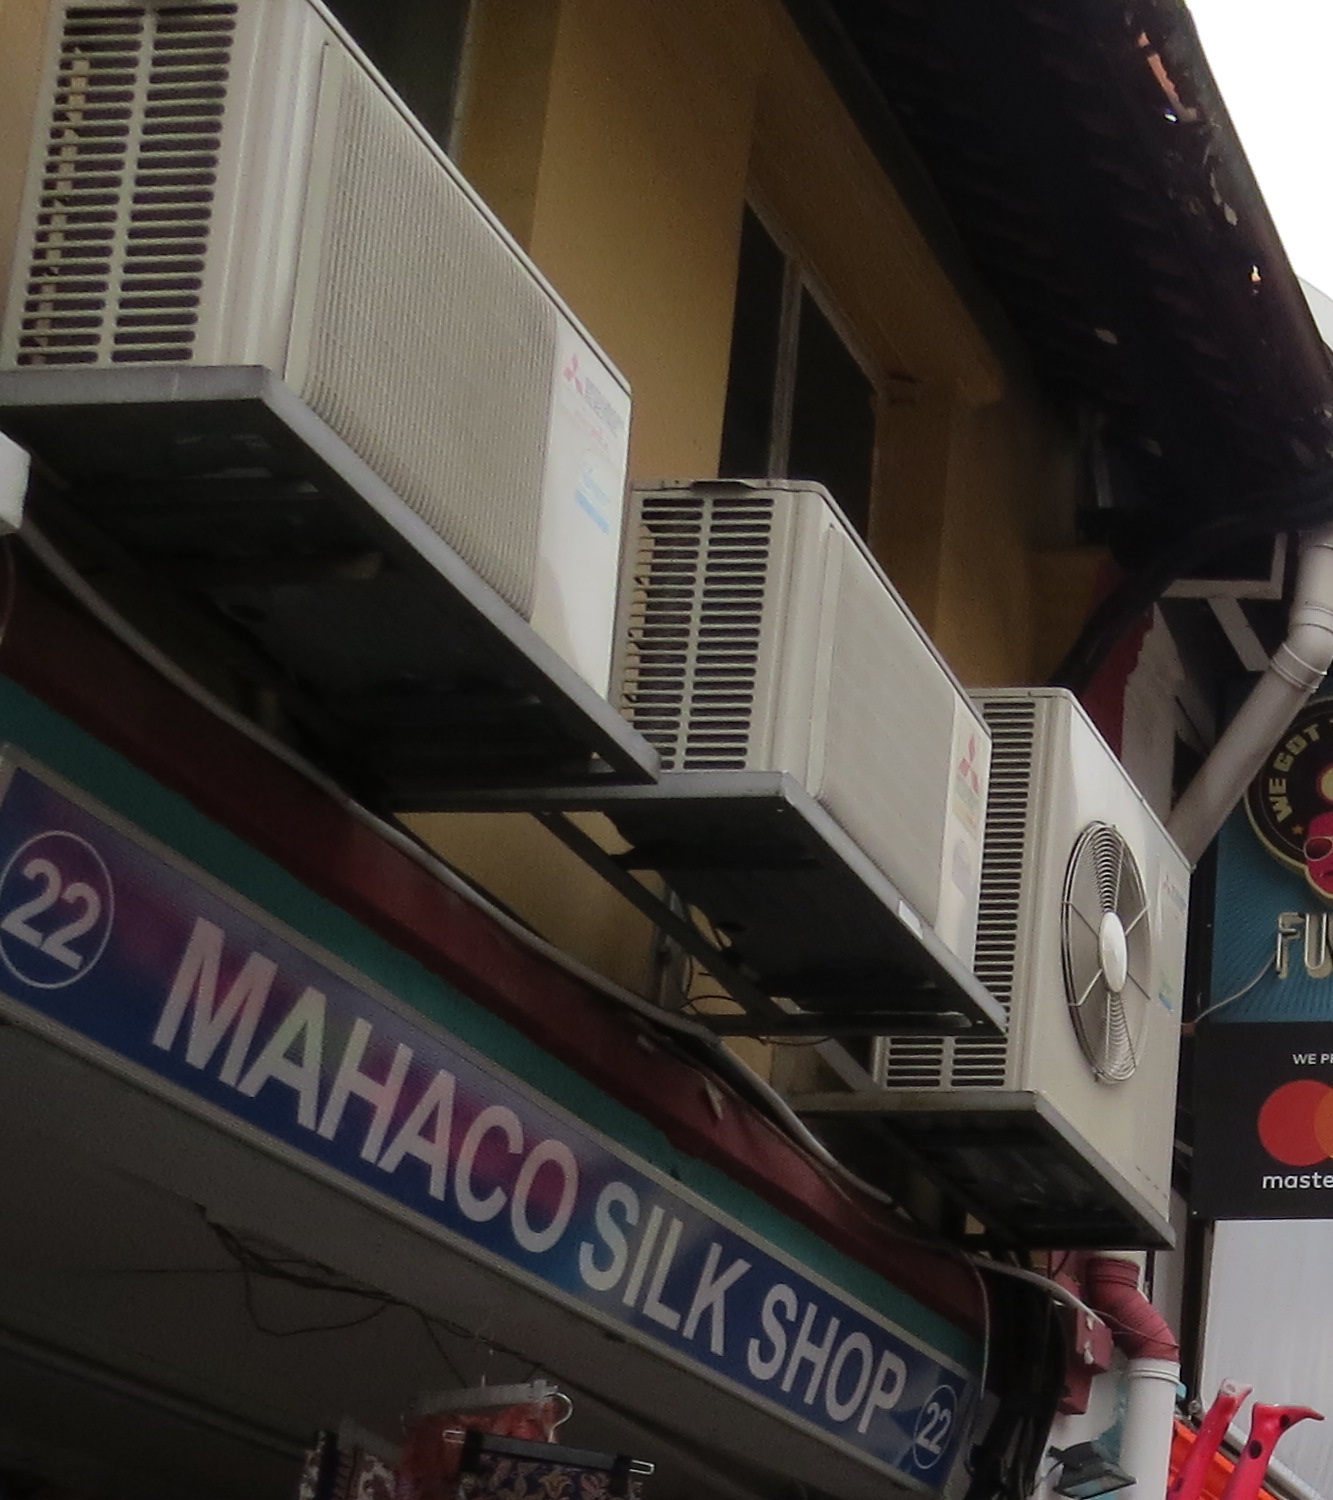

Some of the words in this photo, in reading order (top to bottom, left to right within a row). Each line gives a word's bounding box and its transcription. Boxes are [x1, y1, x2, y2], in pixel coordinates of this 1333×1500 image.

[1275, 723, 1320, 773] GOT
[1264, 776, 1292, 824] WE
[2, 858, 102, 970] 22
[1292, 1052, 1317, 1066] WE
[152, 917, 580, 1253] MAHACO
[578, 1180, 752, 1355] SILK
[748, 1284, 906, 1434] SHOP
[915, 1397, 955, 1449] 22
